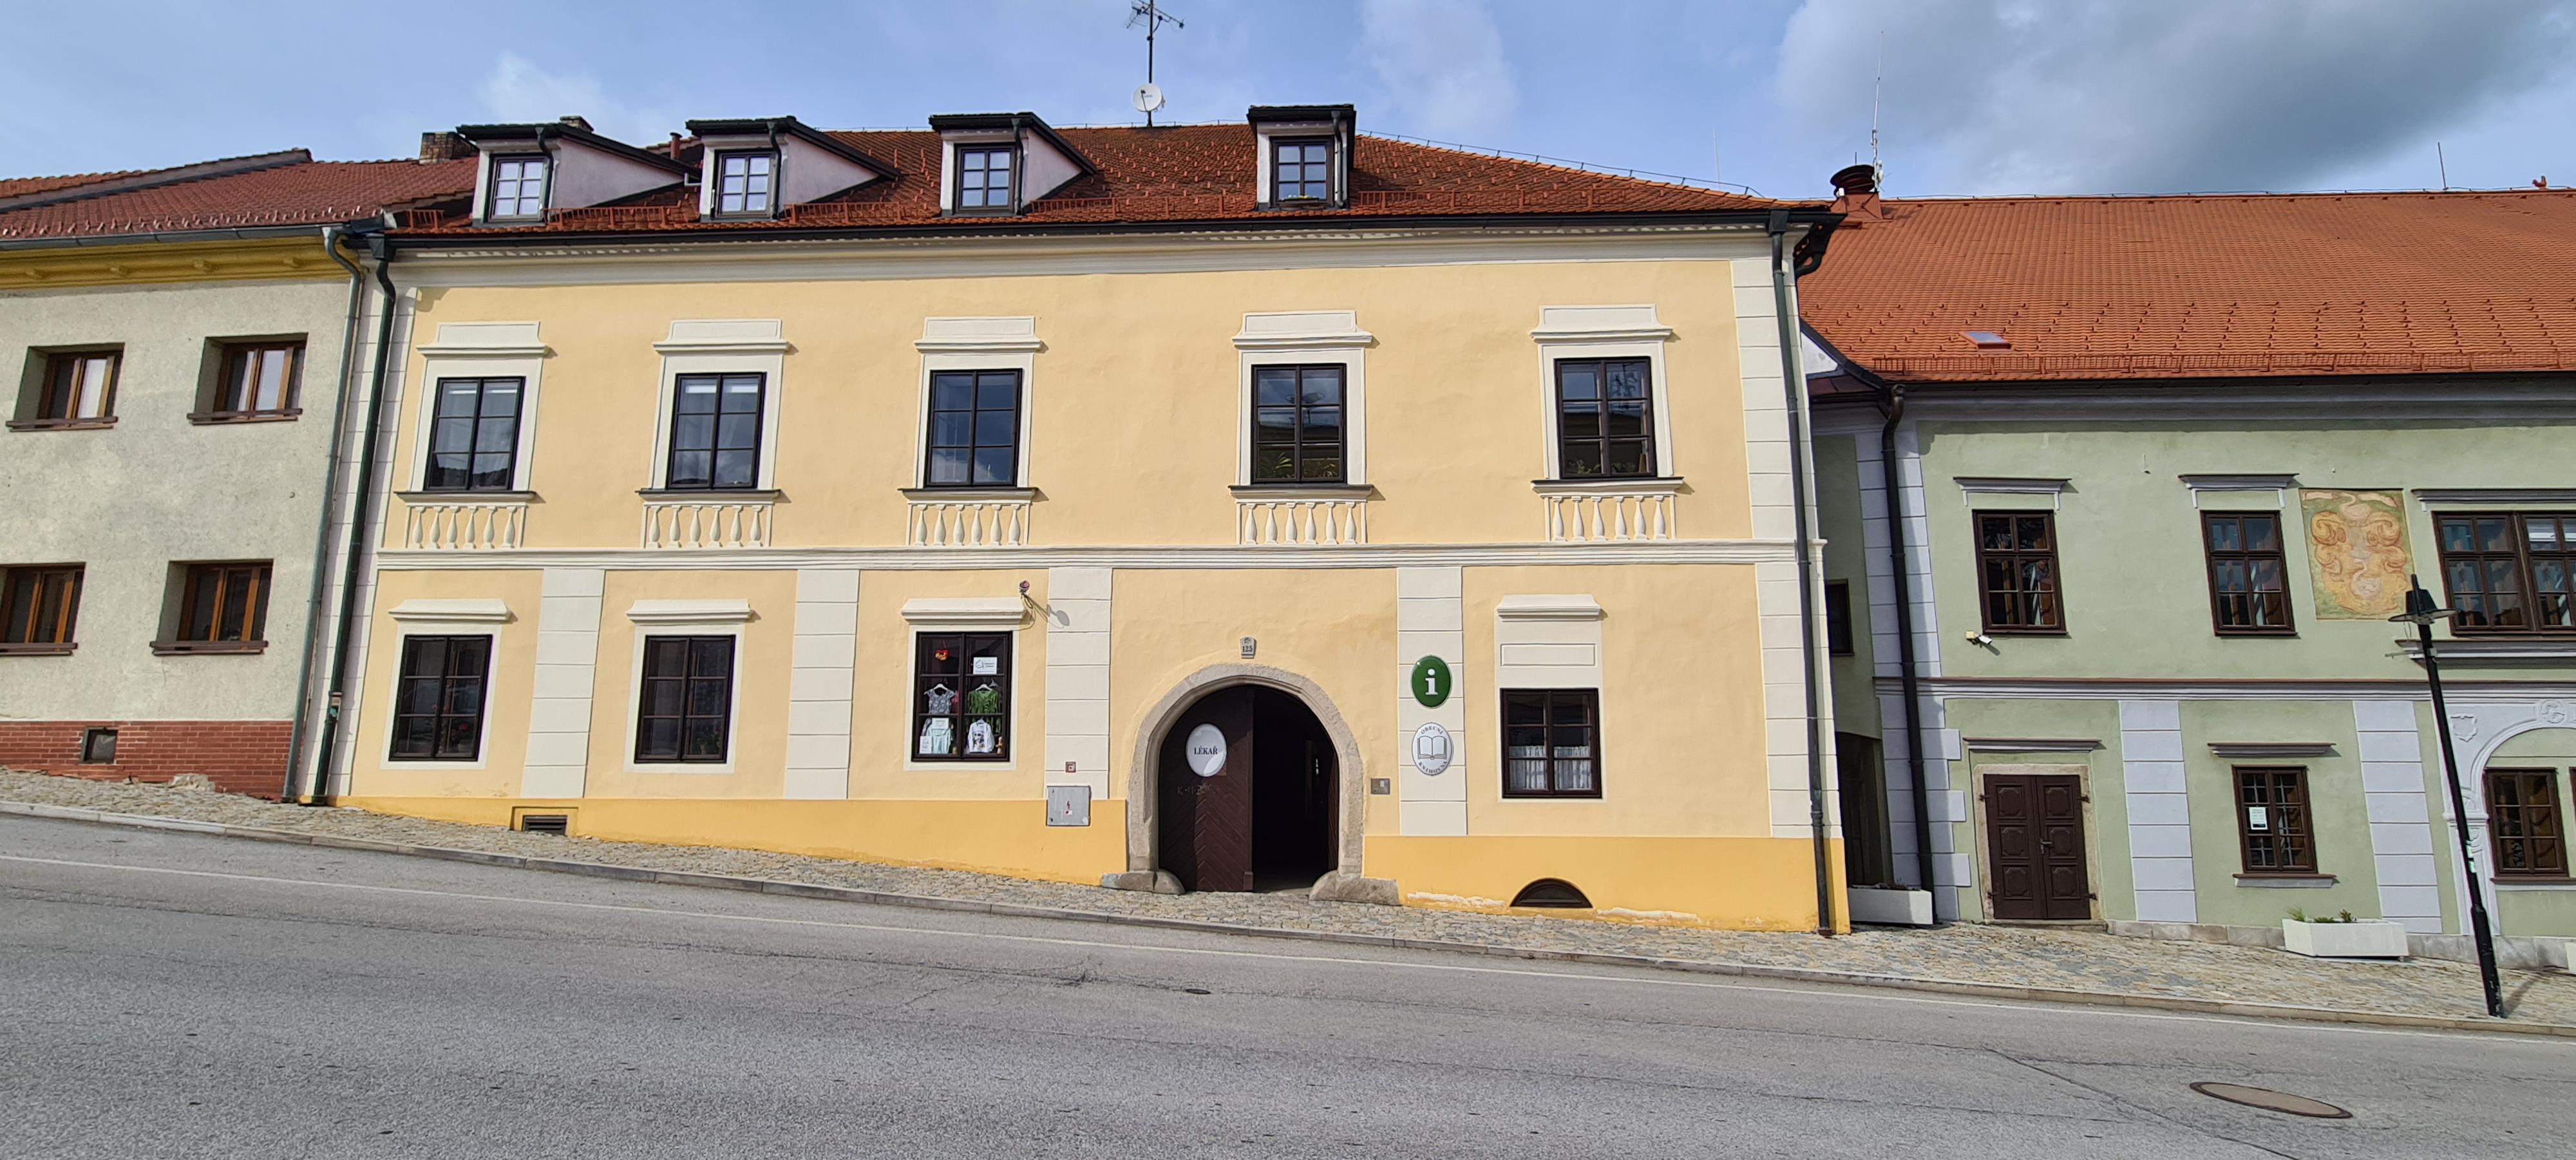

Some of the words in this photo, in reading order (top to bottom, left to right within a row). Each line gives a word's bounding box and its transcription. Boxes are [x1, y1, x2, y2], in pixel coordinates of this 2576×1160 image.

[1242, 645, 1253, 653] 125
[1425, 668, 1439, 695] i
[1193, 745, 1218, 755] LÉKAŘ
[1418, 761, 1448, 774] KNIHOVNA
